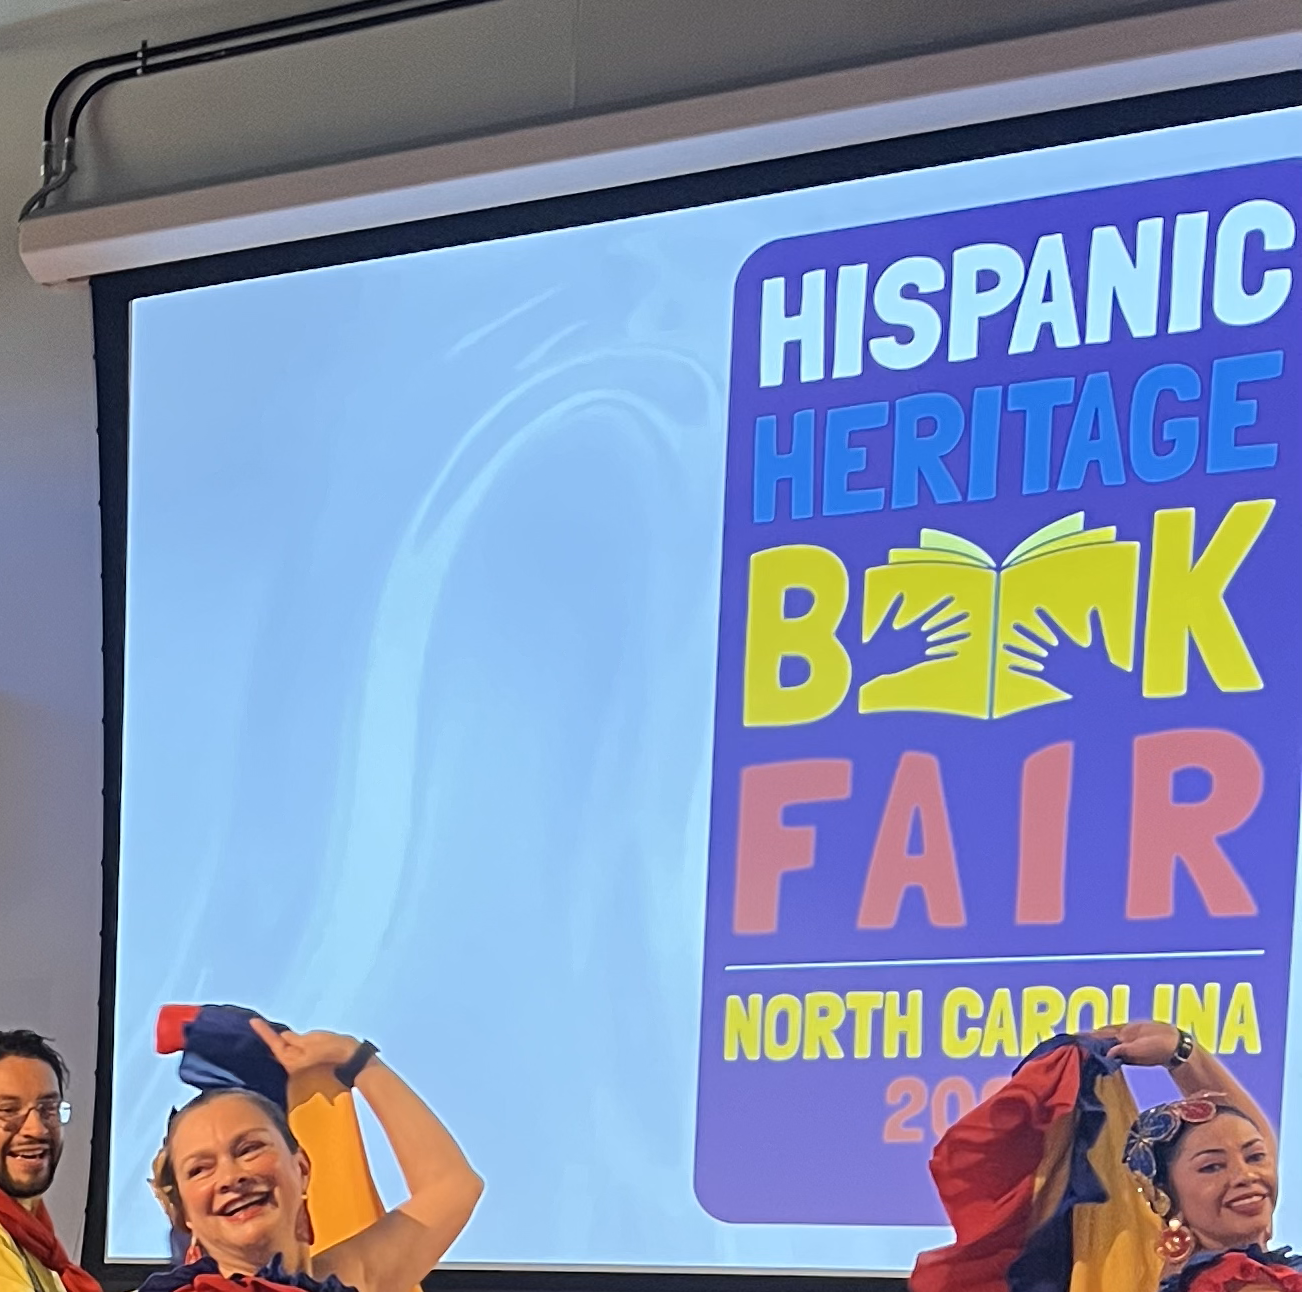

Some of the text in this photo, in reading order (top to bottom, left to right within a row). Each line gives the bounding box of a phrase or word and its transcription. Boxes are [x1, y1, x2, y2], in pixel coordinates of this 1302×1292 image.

[758, 199, 1296, 388] HISPANIC
[753, 350, 1285, 523] HERITAGE
[732, 727, 1263, 936] FAIR
[724, 989, 923, 1062] NORTH
[883, 1075, 1013, 1145] 20
